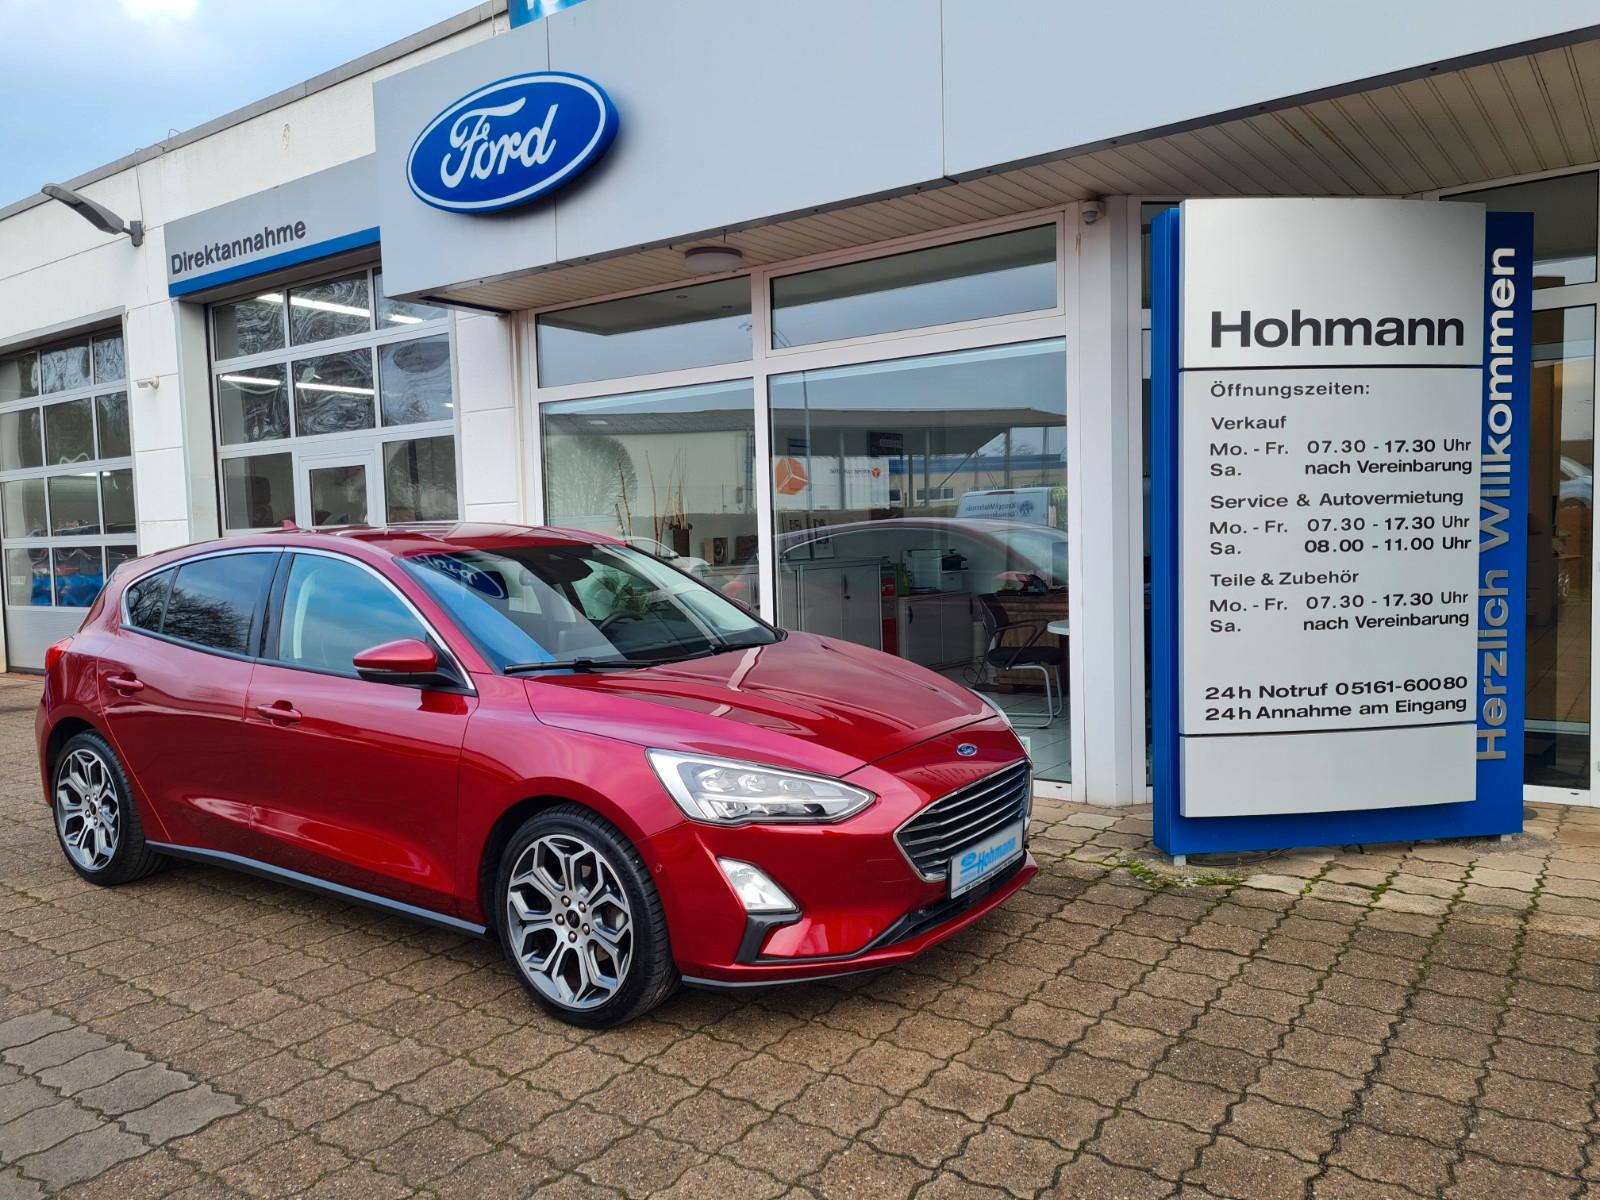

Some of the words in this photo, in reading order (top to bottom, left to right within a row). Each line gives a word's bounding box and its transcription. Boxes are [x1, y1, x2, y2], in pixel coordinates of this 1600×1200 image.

[440, 97, 559, 188] Ford
[171, 220, 306, 275] Direktannahme
[1211, 309, 1465, 348] Hohmann
[1210, 380, 1370, 400] Öffnungszeiten:
[1478, 247, 1516, 553] Willkommen
[1210, 415, 1287, 431] Verkauf
[1210, 442, 1248, 457] Mo.
[1265, 441, 1289, 455] Fr.
[1306, 439, 1366, 454] 07.30
[1384, 439, 1436, 454] 17.30
[1443, 438, 1472, 452] Uhr
[1210, 462, 1242, 477] Sa.
[1304, 460, 1351, 475] nach
[1356, 458, 1473, 475] Vereinbarung
[1210, 494, 1289, 510] Service
[1296, 493, 1311, 507] &
[1319, 490, 1464, 507] Autovermietung
[1209, 521, 1247, 535] Mo.
[1265, 519, 1288, 534] Fr.
[1307, 517, 1366, 533] 07.30
[1384, 515, 1436, 531] 17.30
[1442, 515, 1471, 529] Uhr
[1210, 541, 1241, 556] Sa.
[1304, 538, 1364, 553] 08.00
[1384, 537, 1435, 552] 11.00
[1442, 536, 1472, 550] Uhr
[1209, 573, 1256, 587] Teile
[1260, 572, 1275, 586] &
[1278, 569, 1360, 586] Zubehör
[1209, 599, 1247, 613] Mo.
[1264, 597, 1288, 611] Fr.
[1306, 594, 1365, 610] 07.30
[1383, 592, 1434, 607] 17.30
[1440, 591, 1469, 605] Uhr
[1210, 619, 1241, 633] Sa.
[1303, 616, 1349, 631] nach
[1354, 612, 1470, 629] Vereinbarung
[1476, 569, 1509, 761] Herzlich
[1259, 682, 1329, 699] Notruf
[1335, 675, 1468, 696] 05161-60080
[1255, 704, 1352, 720] Annahme
[1359, 703, 1389, 716] am
[1395, 698, 1467, 715] Eingang
